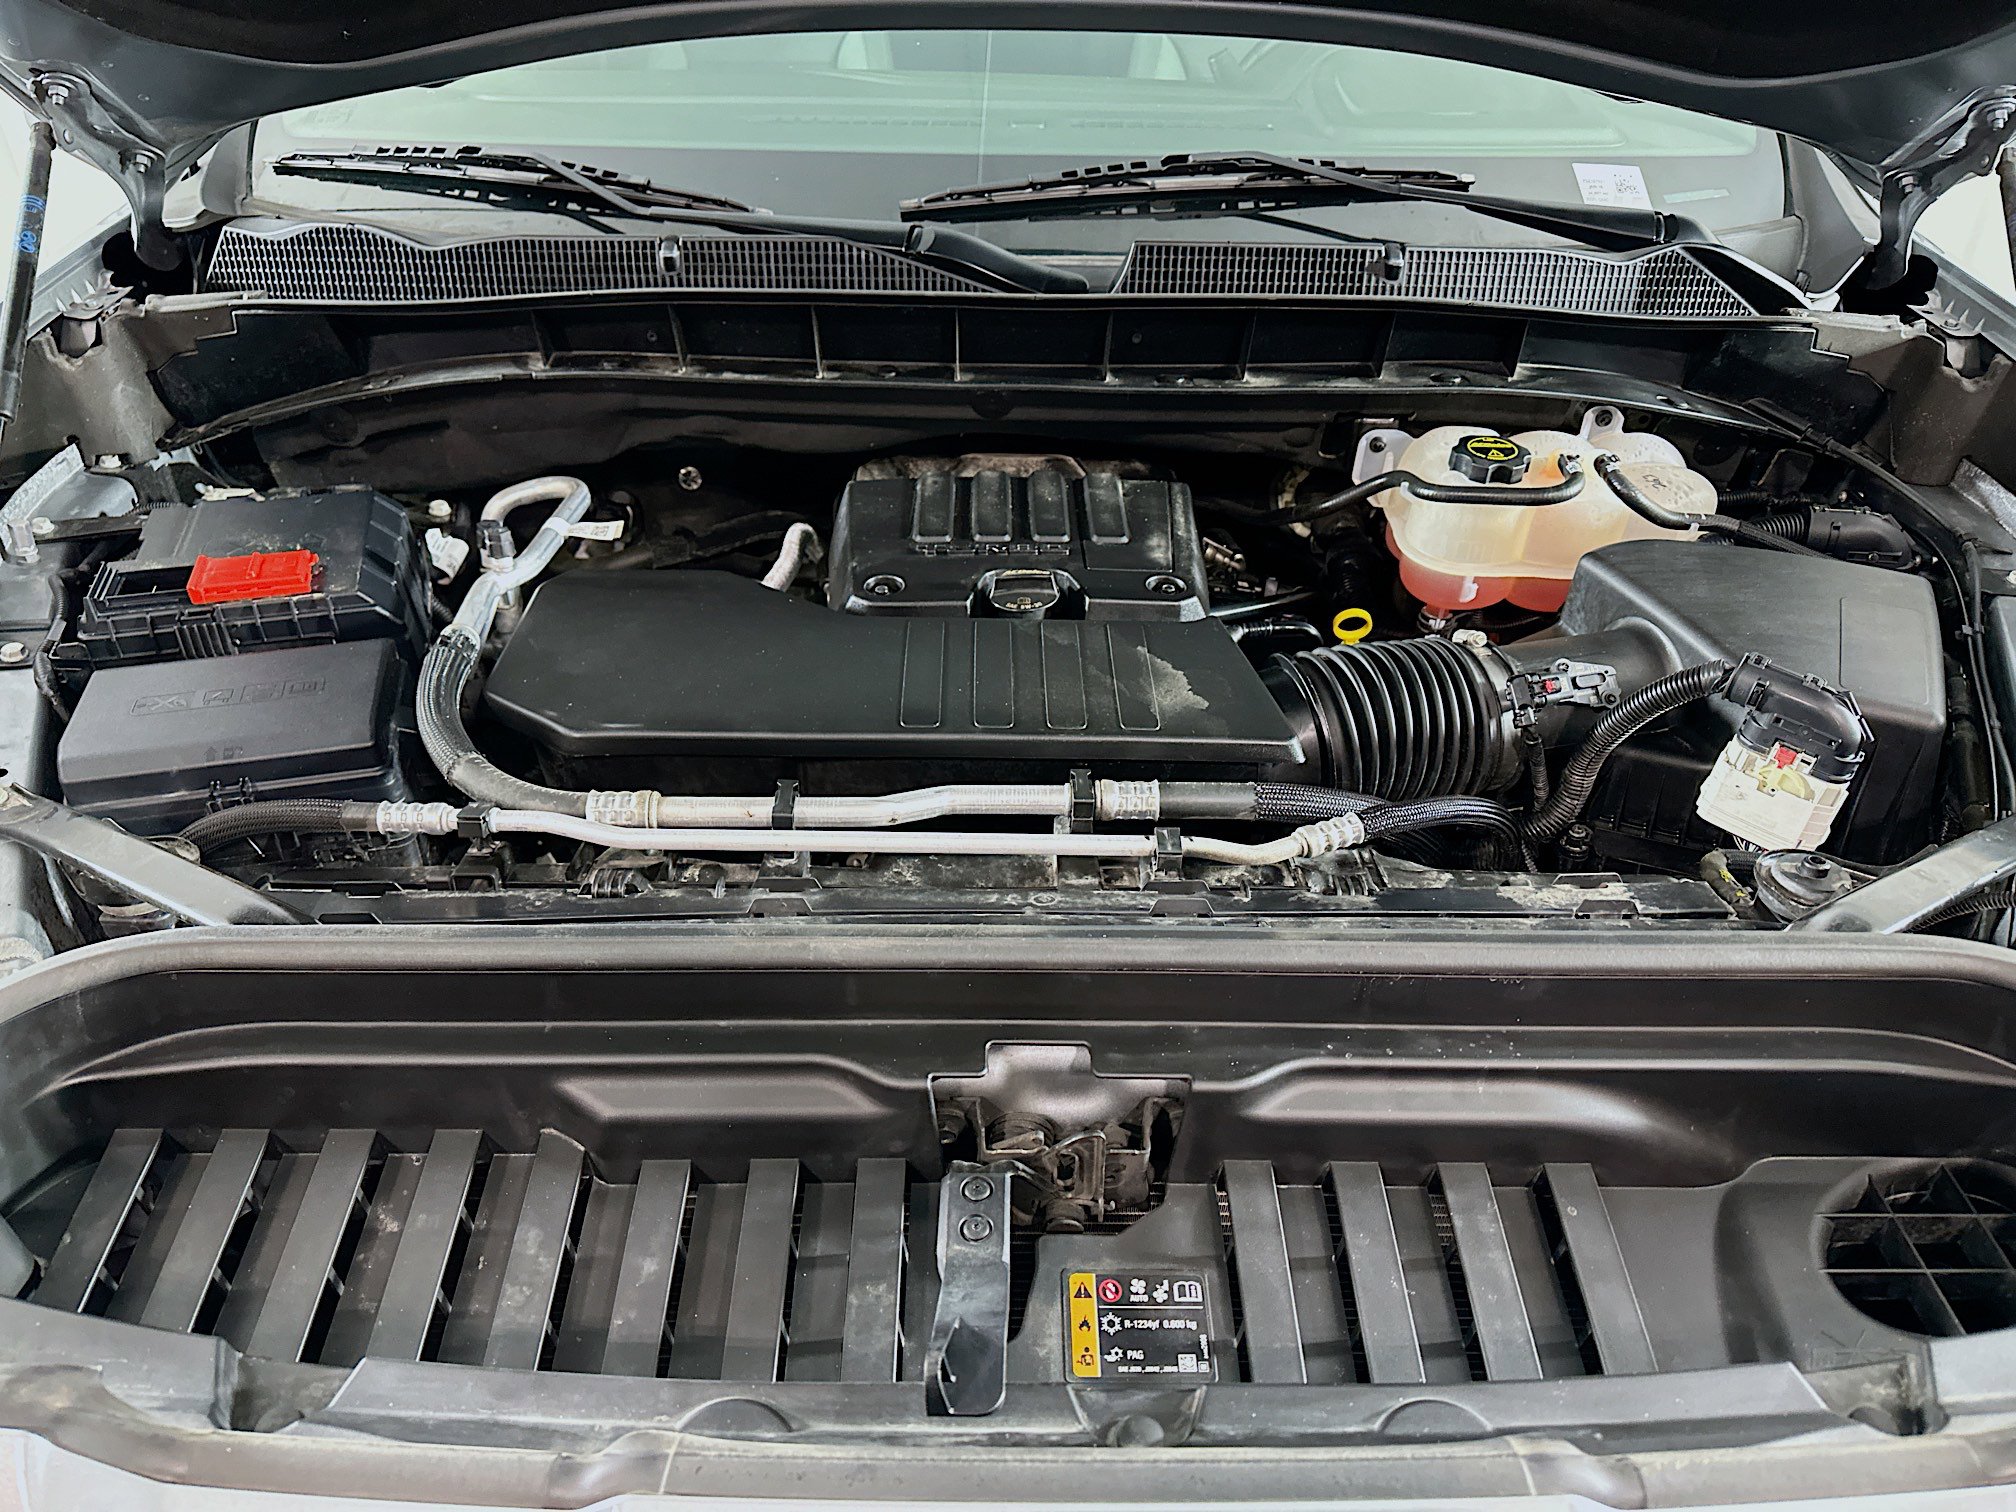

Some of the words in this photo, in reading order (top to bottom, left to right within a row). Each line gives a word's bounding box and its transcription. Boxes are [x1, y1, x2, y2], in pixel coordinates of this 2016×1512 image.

[1130, 1294, 1148, 1302] AUTO
[1124, 1319, 1160, 1330] R-1234yf
[1186, 1319, 1198, 1330] kg
[1126, 1350, 1144, 1360] PAG
